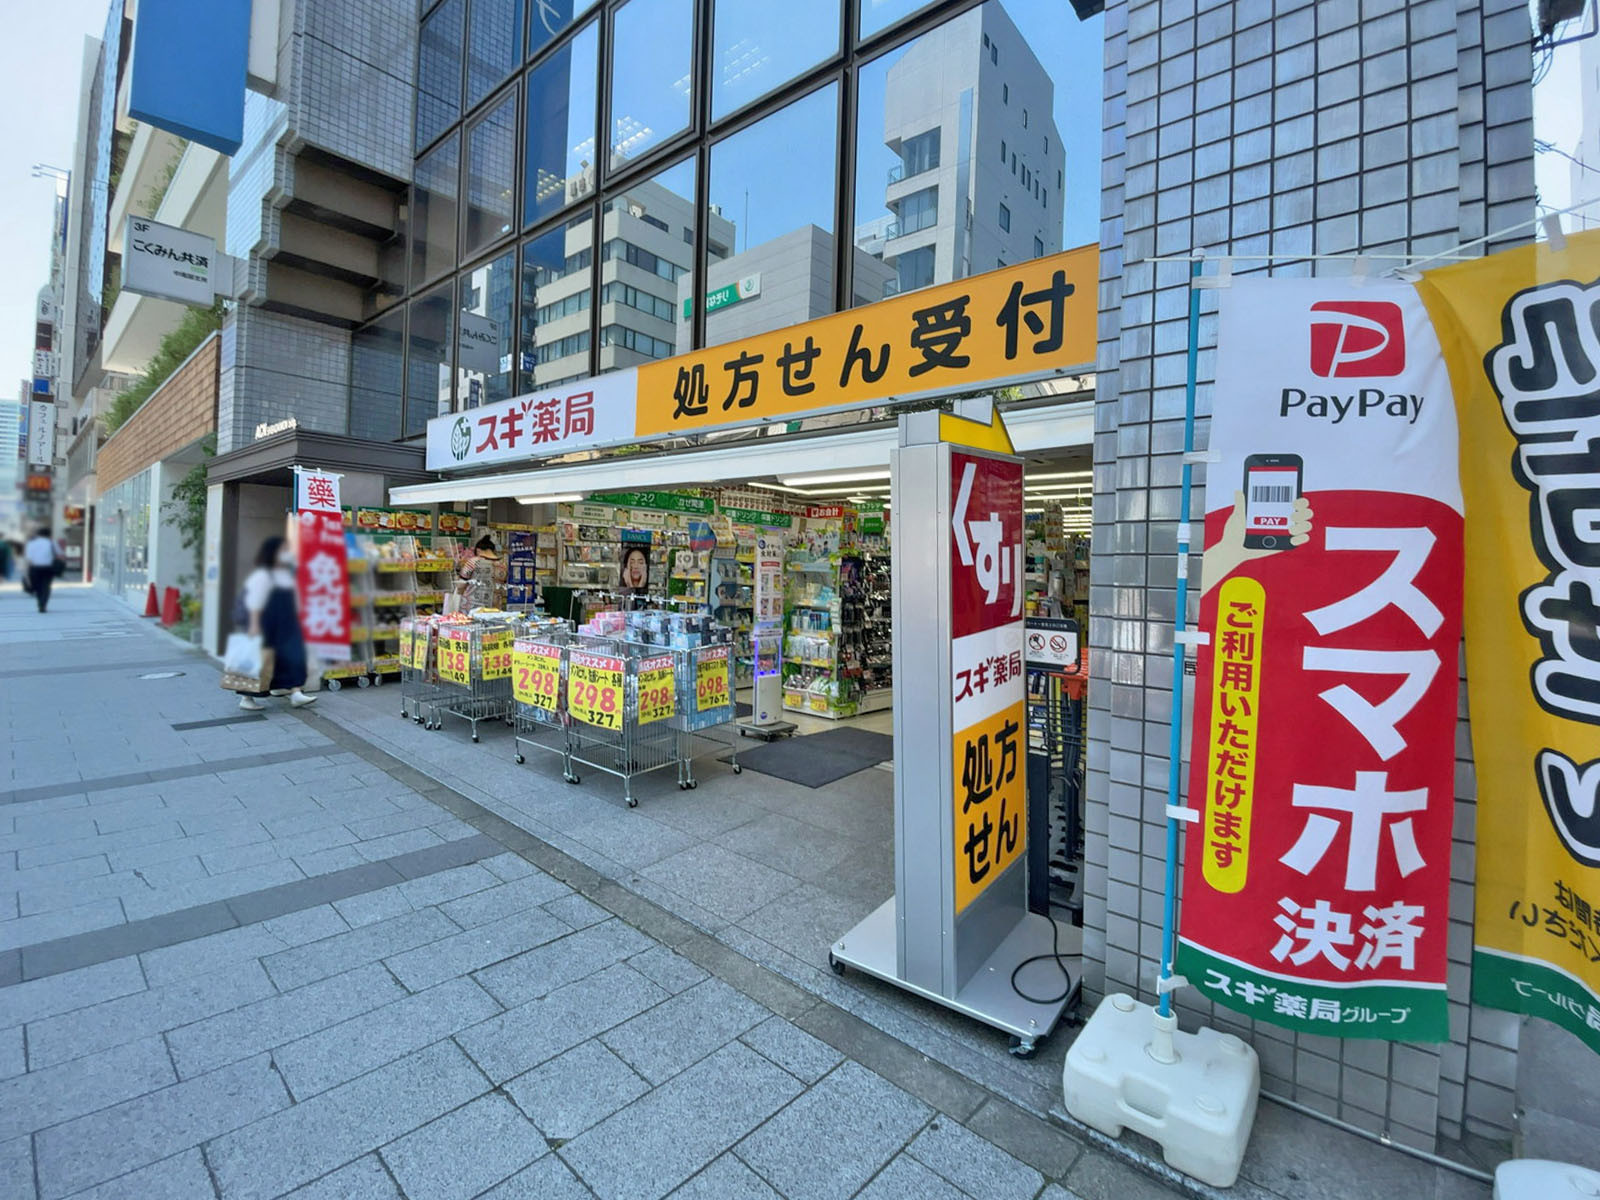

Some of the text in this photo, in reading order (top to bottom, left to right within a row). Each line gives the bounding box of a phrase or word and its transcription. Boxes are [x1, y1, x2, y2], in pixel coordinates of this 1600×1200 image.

[133, 222, 150, 232] 3F
[133, 239, 208, 268] こくみん共済
[673, 270, 1075, 419] 処方せん受付
[476, 391, 595, 454] スギ薬局
[1280, 388, 1424, 424] PayPay
[632, 492, 655, 503] マスク
[1260, 517, 1281, 526] PAY
[952, 463, 1021, 617] くすり
[955, 650, 1022, 703] スギ薬局
[1210, 601, 1257, 868] ご利用いただけます
[1278, 526, 1445, 892] スマホ
[962, 720, 1019, 814] 処方
[964, 798, 1018, 884] せん
[1269, 896, 1425, 972] 決済
[1204, 968, 1411, 1023] スギ薬局グループ
